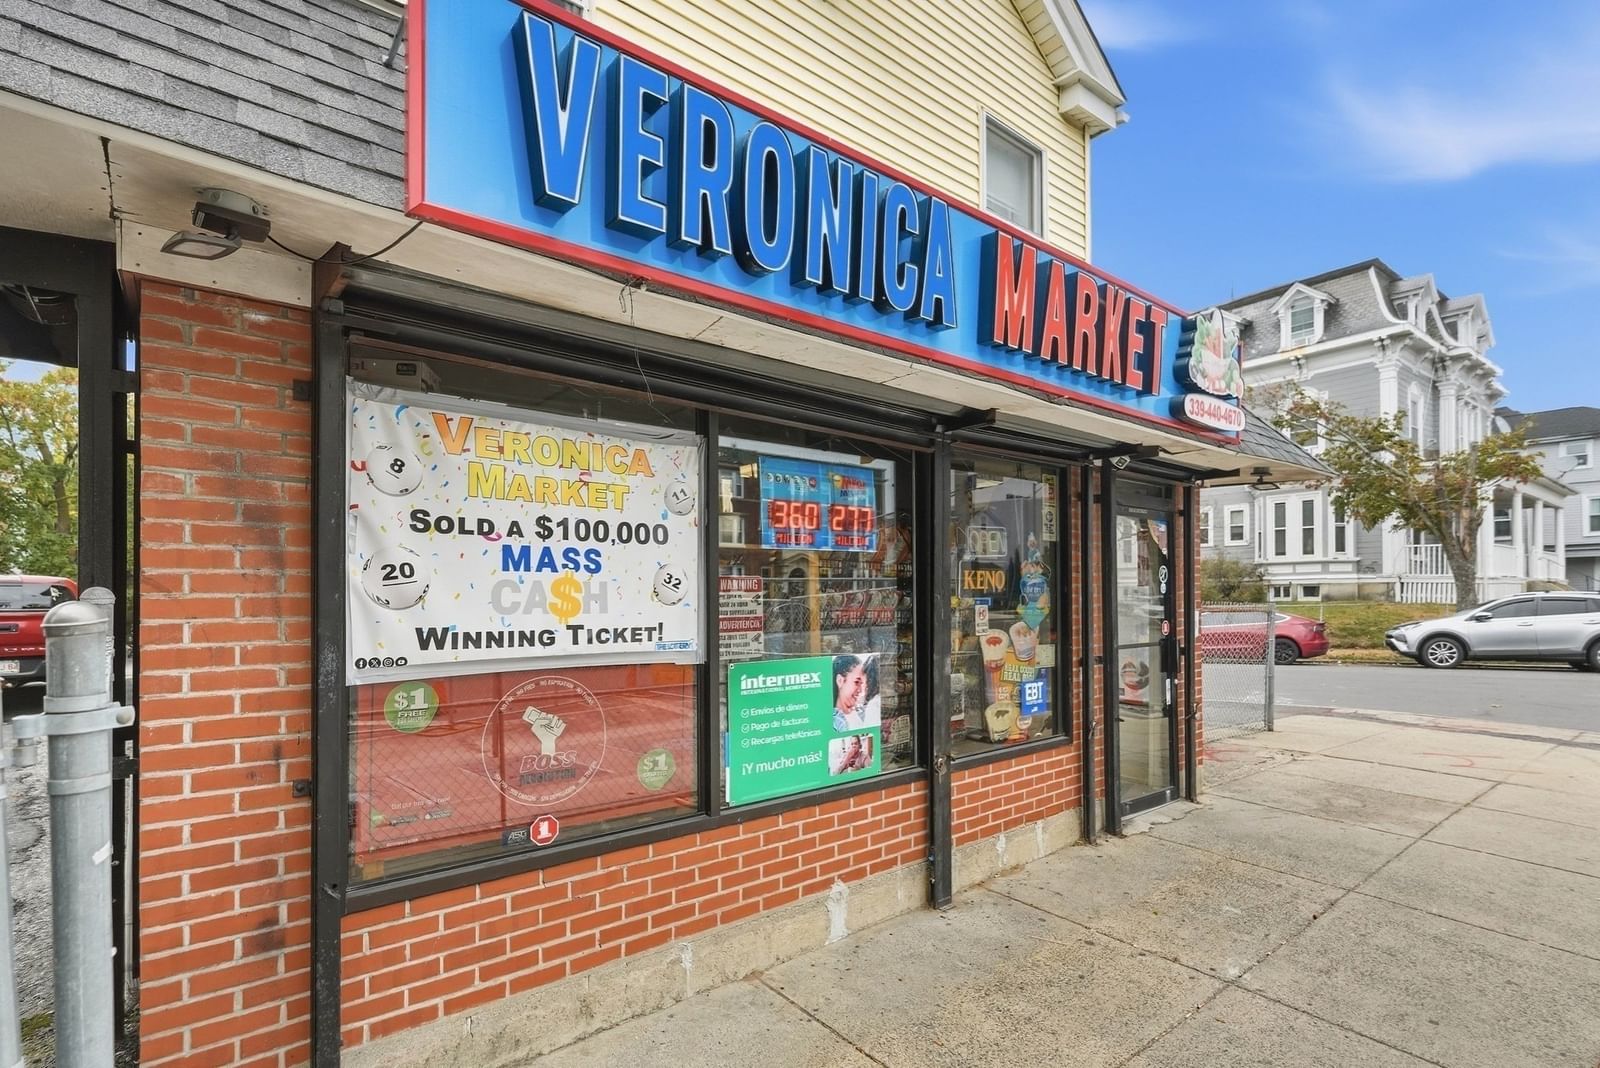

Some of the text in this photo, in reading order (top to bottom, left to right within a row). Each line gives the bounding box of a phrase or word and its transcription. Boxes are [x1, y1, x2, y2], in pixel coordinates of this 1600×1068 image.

[517, 8, 1168, 397] VERONICA MARKET
[1188, 397, 1243, 428] 339-440-4670
[431, 410, 656, 478] VERONICA
[389, 457, 406, 474] 8
[467, 460, 630, 510] MARKET
[671, 487, 688, 503] 11
[409, 508, 669, 547] SOLD A $100,000
[774, 501, 873, 532] 360 277
[501, 543, 604, 576] MASS
[380, 562, 415, 582] 20
[663, 572, 682, 590] 32
[963, 569, 1006, 593] KENO
[720, 579, 758, 590] WARNING
[490, 569, 609, 625] CA$H
[415, 622, 664, 651] WINNING TICKET!
[740, 671, 822, 690] intermex
[1024, 682, 1044, 701] EBT
[394, 687, 429, 711] $1
[775, 705, 785, 713] de
[785, 703, 809, 712] dinero
[750, 717, 809, 732] Pago de facturas
[750, 735, 785, 746] Recargas
[519, 750, 578, 774] BOSS
[643, 752, 669, 772] $1
[756, 757, 796, 774] mucho
[797, 750, 823, 766] más!
